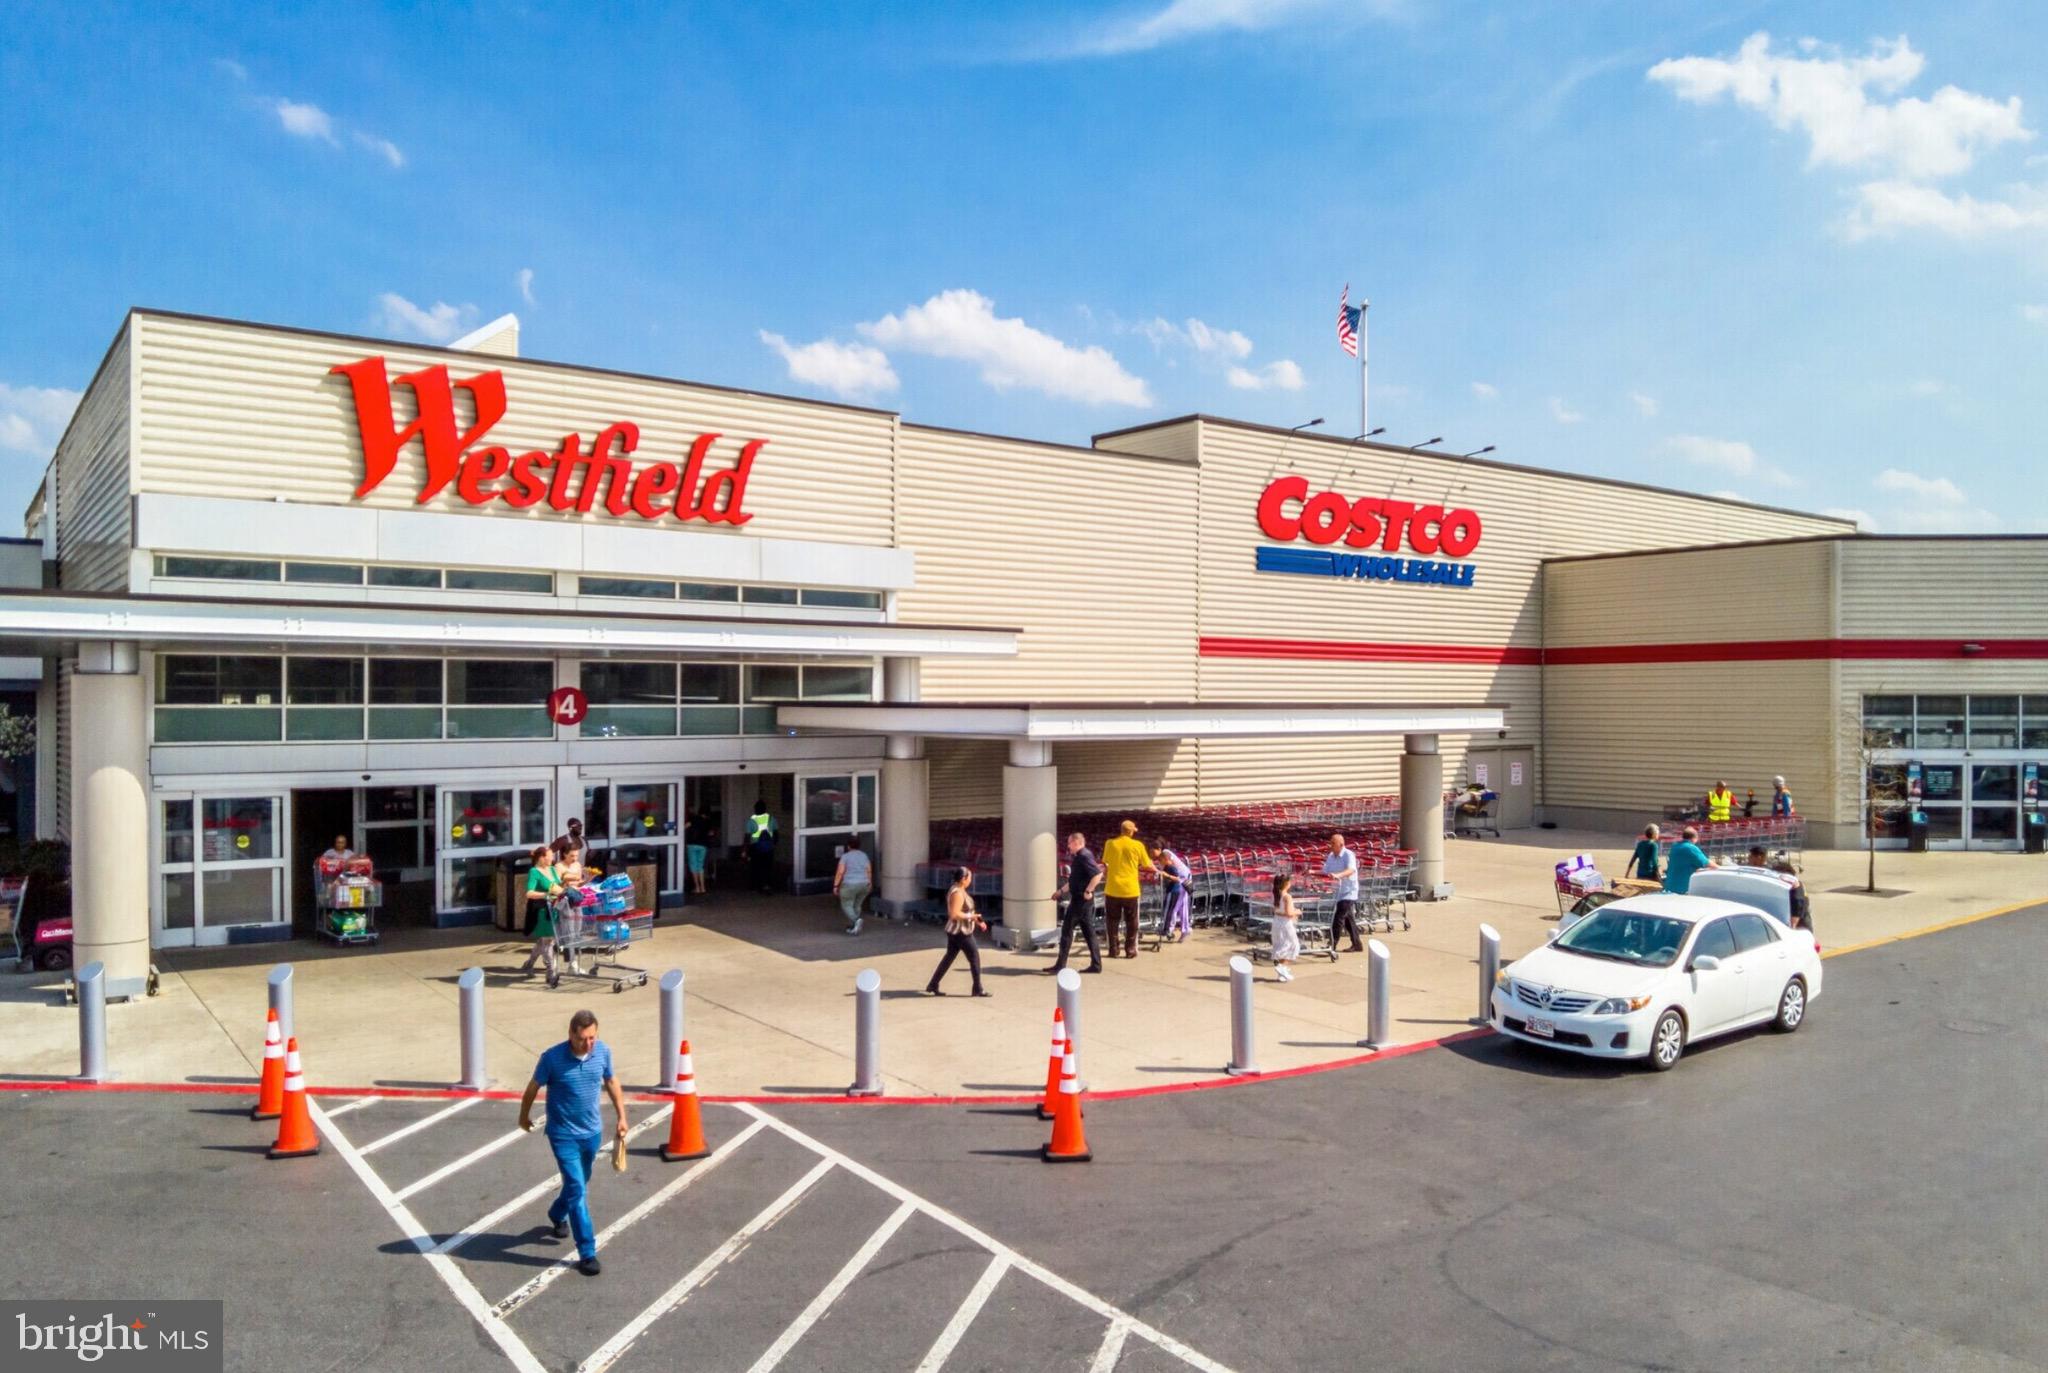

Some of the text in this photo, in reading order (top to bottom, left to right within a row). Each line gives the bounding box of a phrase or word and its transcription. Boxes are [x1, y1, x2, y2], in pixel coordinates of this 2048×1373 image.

[329, 355, 770, 526] Westfield
[1256, 475, 1482, 558] COSTCO
[1331, 552, 1476, 587] WHOLESALE
[559, 694, 578, 719] 4
